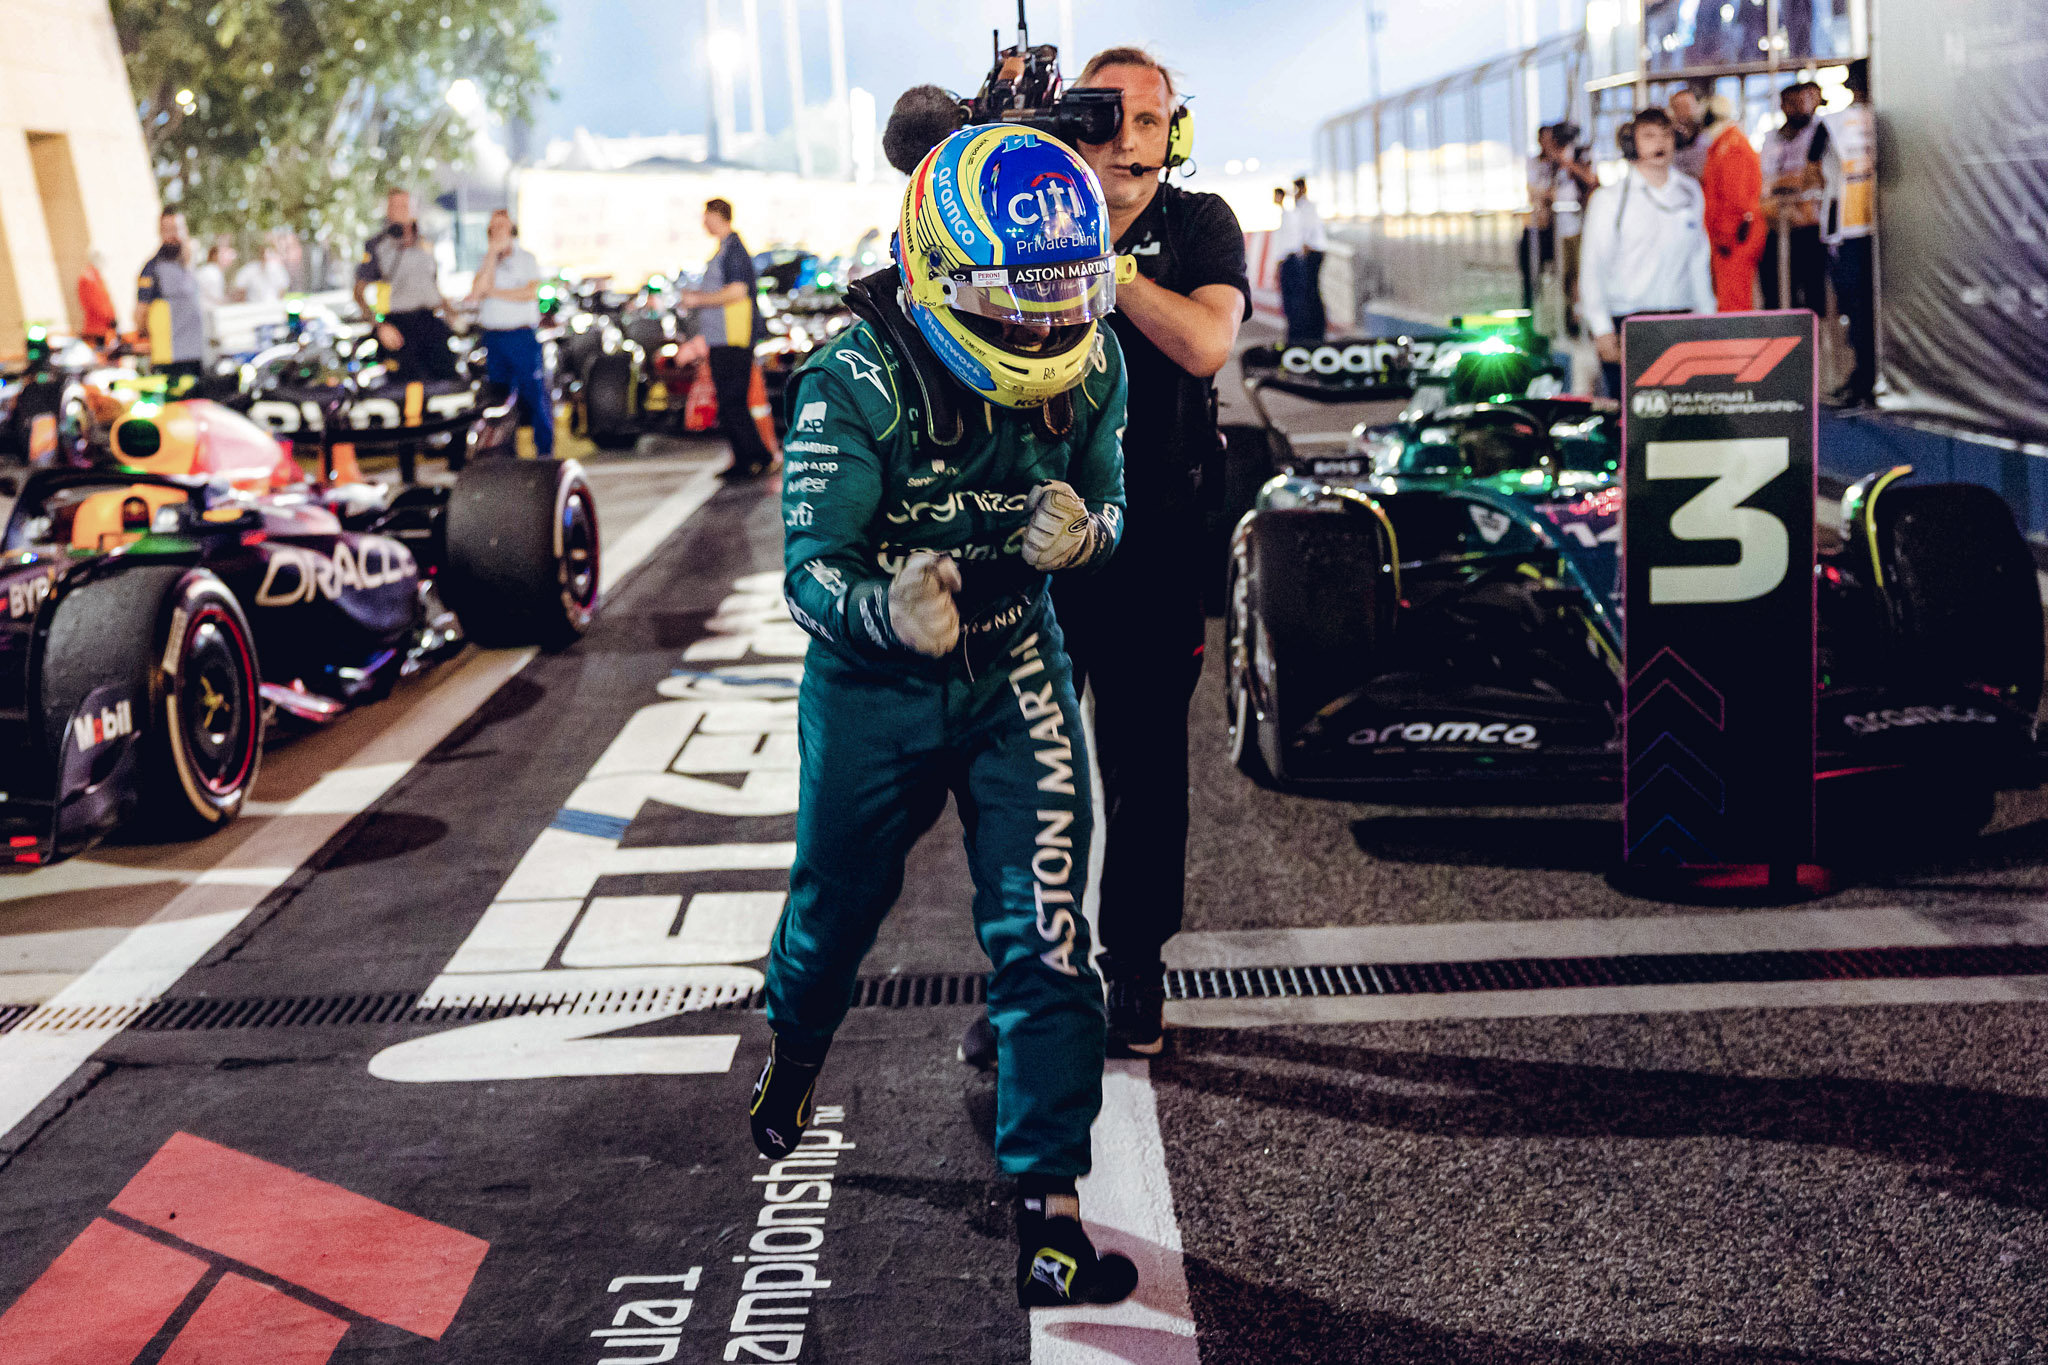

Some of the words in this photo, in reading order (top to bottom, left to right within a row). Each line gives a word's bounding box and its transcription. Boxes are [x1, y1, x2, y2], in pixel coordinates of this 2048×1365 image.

[938, 166, 975, 245] aramco
[1007, 173, 1081, 226] citi
[1016, 234, 1068, 255] Private
[1071, 232, 1098, 247] Bank
[1015, 266, 1065, 284] ASTON
[1068, 260, 1109, 278] MARTIN
[1646, 437, 1789, 605] 3
[73, 700, 133, 752] Mobil
[1347, 721, 1537, 745] aramco
[1031, 809, 1079, 978] ASTON
